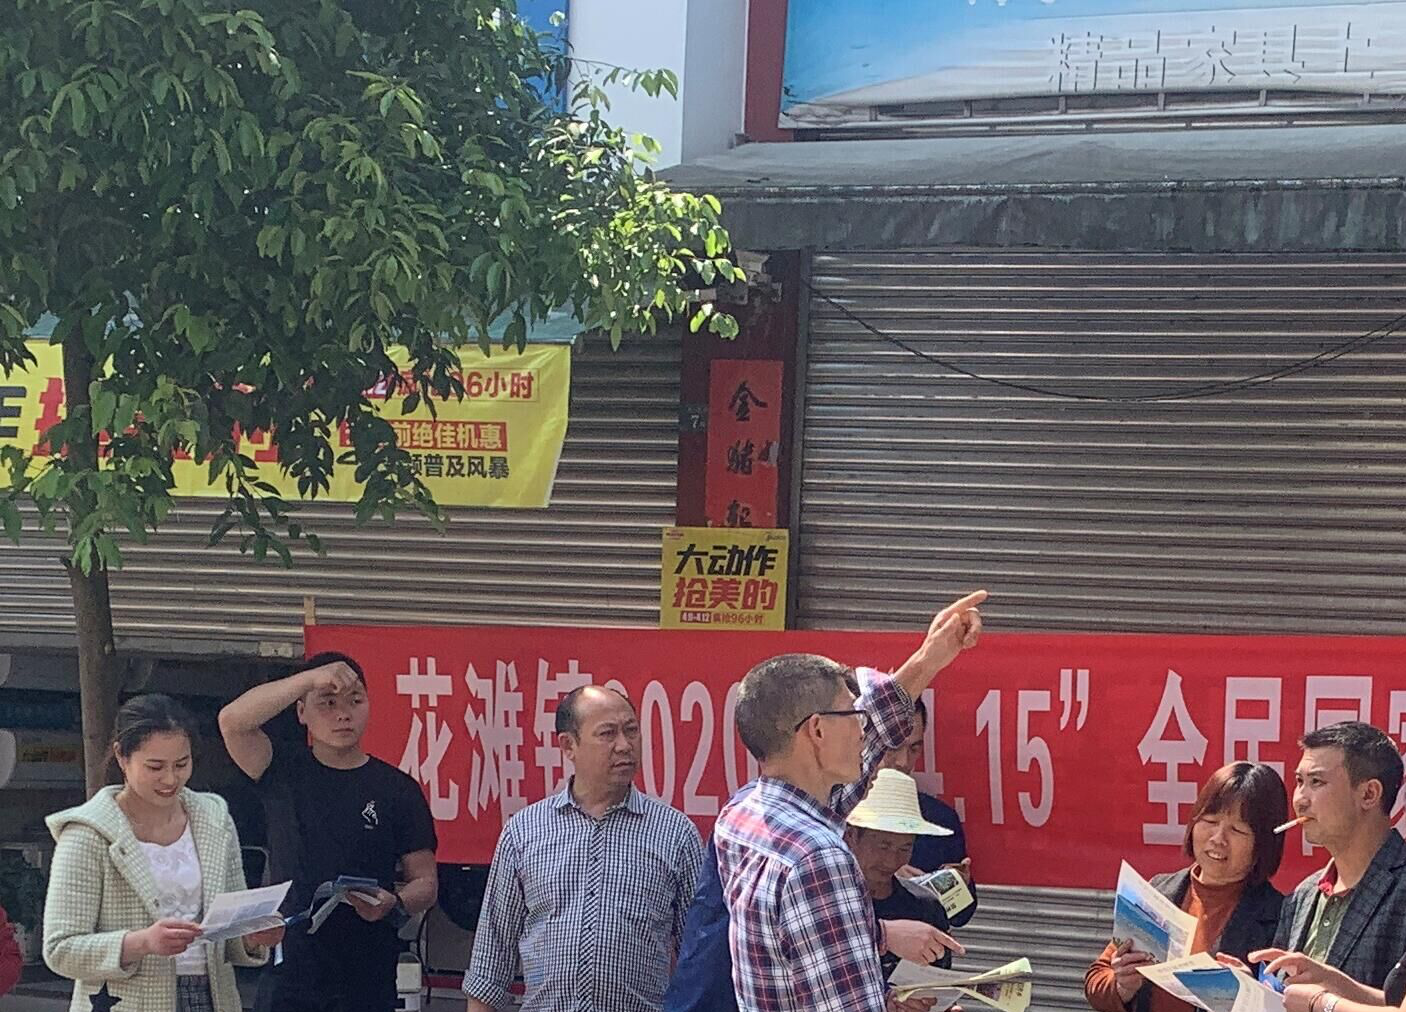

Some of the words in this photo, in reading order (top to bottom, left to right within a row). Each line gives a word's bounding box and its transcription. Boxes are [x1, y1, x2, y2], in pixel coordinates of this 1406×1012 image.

[345, 418, 502, 450] 前绝佳机惠
[674, 543, 779, 576] 大动作
[672, 576, 778, 611] 抢美的
